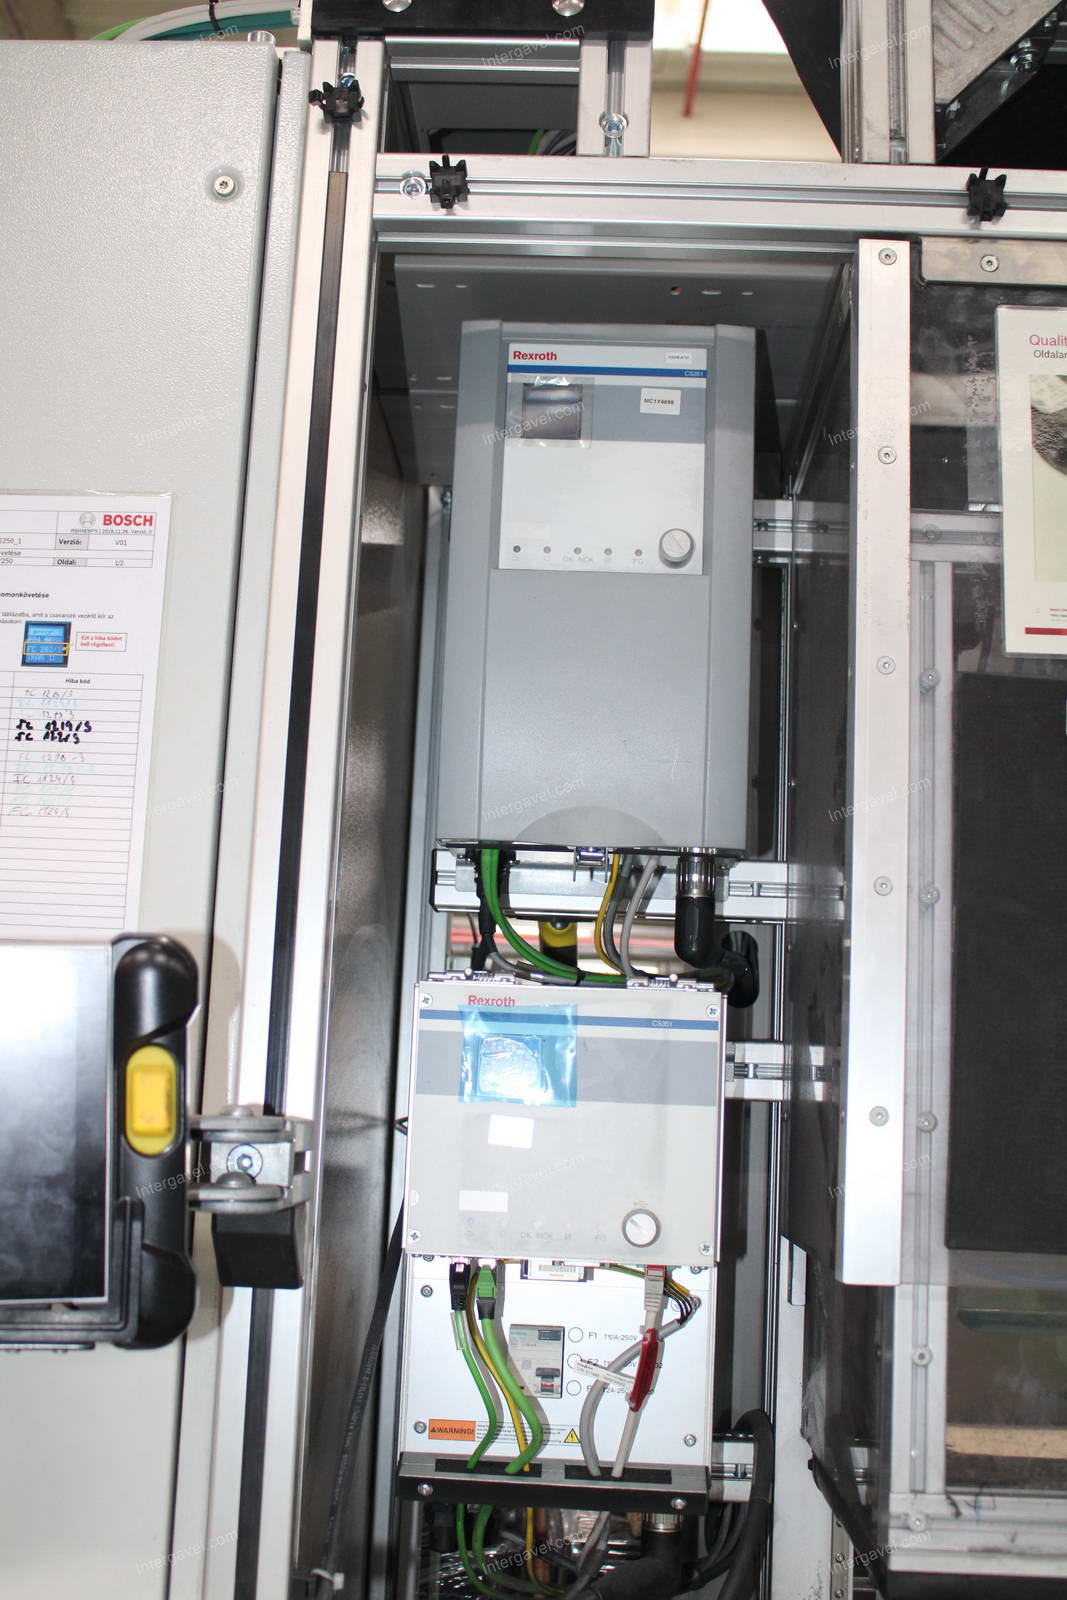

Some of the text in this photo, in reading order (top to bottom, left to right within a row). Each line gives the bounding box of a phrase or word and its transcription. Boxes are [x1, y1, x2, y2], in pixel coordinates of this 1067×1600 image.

[513, 351, 557, 361] Rexroth
[103, 514, 153, 527] BOSCH
[467, 995, 515, 1007] Rexroth
[588, 1332, 597, 1340] F1
